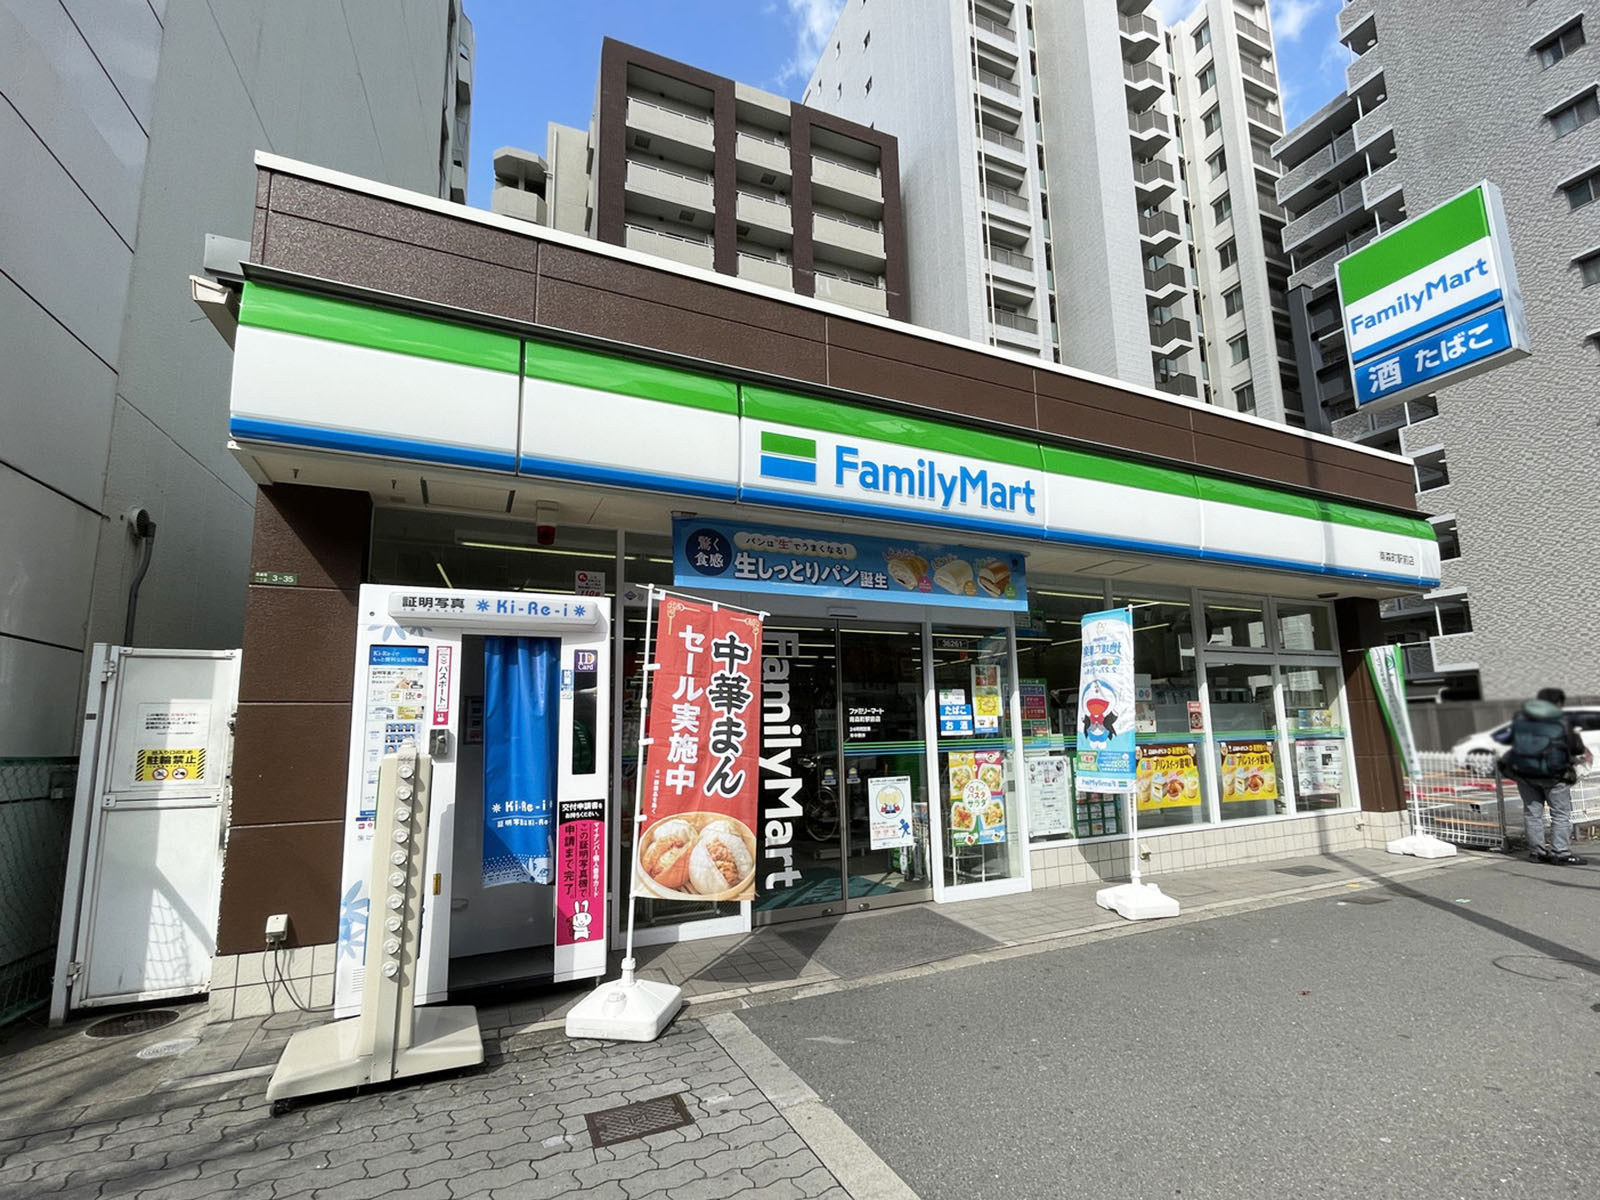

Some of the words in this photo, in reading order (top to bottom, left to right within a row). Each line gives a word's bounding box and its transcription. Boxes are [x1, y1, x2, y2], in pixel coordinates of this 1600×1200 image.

[1350, 258, 1489, 335] FamilyMart
[1368, 356, 1402, 393] 酒
[1415, 323, 1493, 372] たばこ
[835, 444, 1036, 515] FamilyMart
[697, 535, 720, 551] 驚く
[695, 553, 724, 567] 食感
[271, 574, 294, 583] 3-35
[734, 552, 889, 589] 生しっとりパン誕生
[402, 596, 465, 610] 証明写真
[496, 599, 568, 616] Ki-Re-i
[577, 662, 594, 670] Card
[578, 652, 595, 664] ID
[665, 625, 705, 795] セール実施中
[704, 632, 754, 798] 中華まん
[944, 705, 968, 715] たばこ
[146, 755, 197, 765] 駐輪禁止
[759, 632, 803, 890] FamilyMart
[577, 823, 589, 898] この証明写真機で
